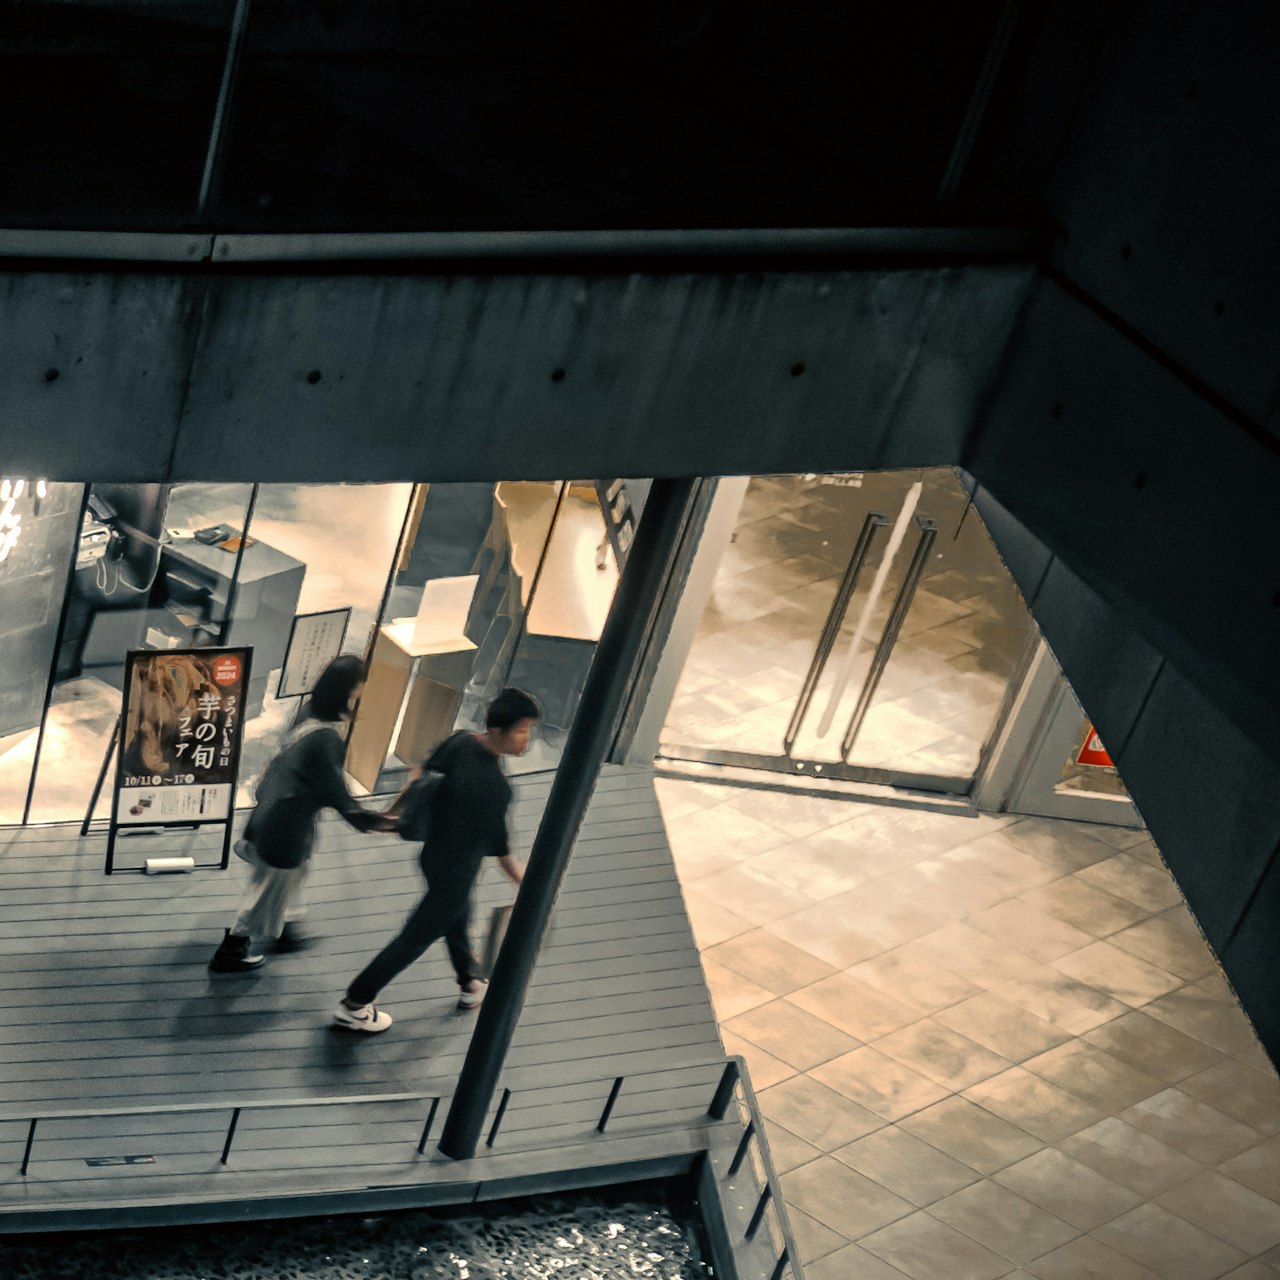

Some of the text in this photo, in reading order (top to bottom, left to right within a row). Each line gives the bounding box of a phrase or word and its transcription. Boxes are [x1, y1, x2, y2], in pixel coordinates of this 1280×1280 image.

[215, 671, 236, 680] 2024
[175, 716, 193, 758] フェア
[191, 691, 221, 769] 芋の旬
[220, 695, 236, 767] さつまいもの日
